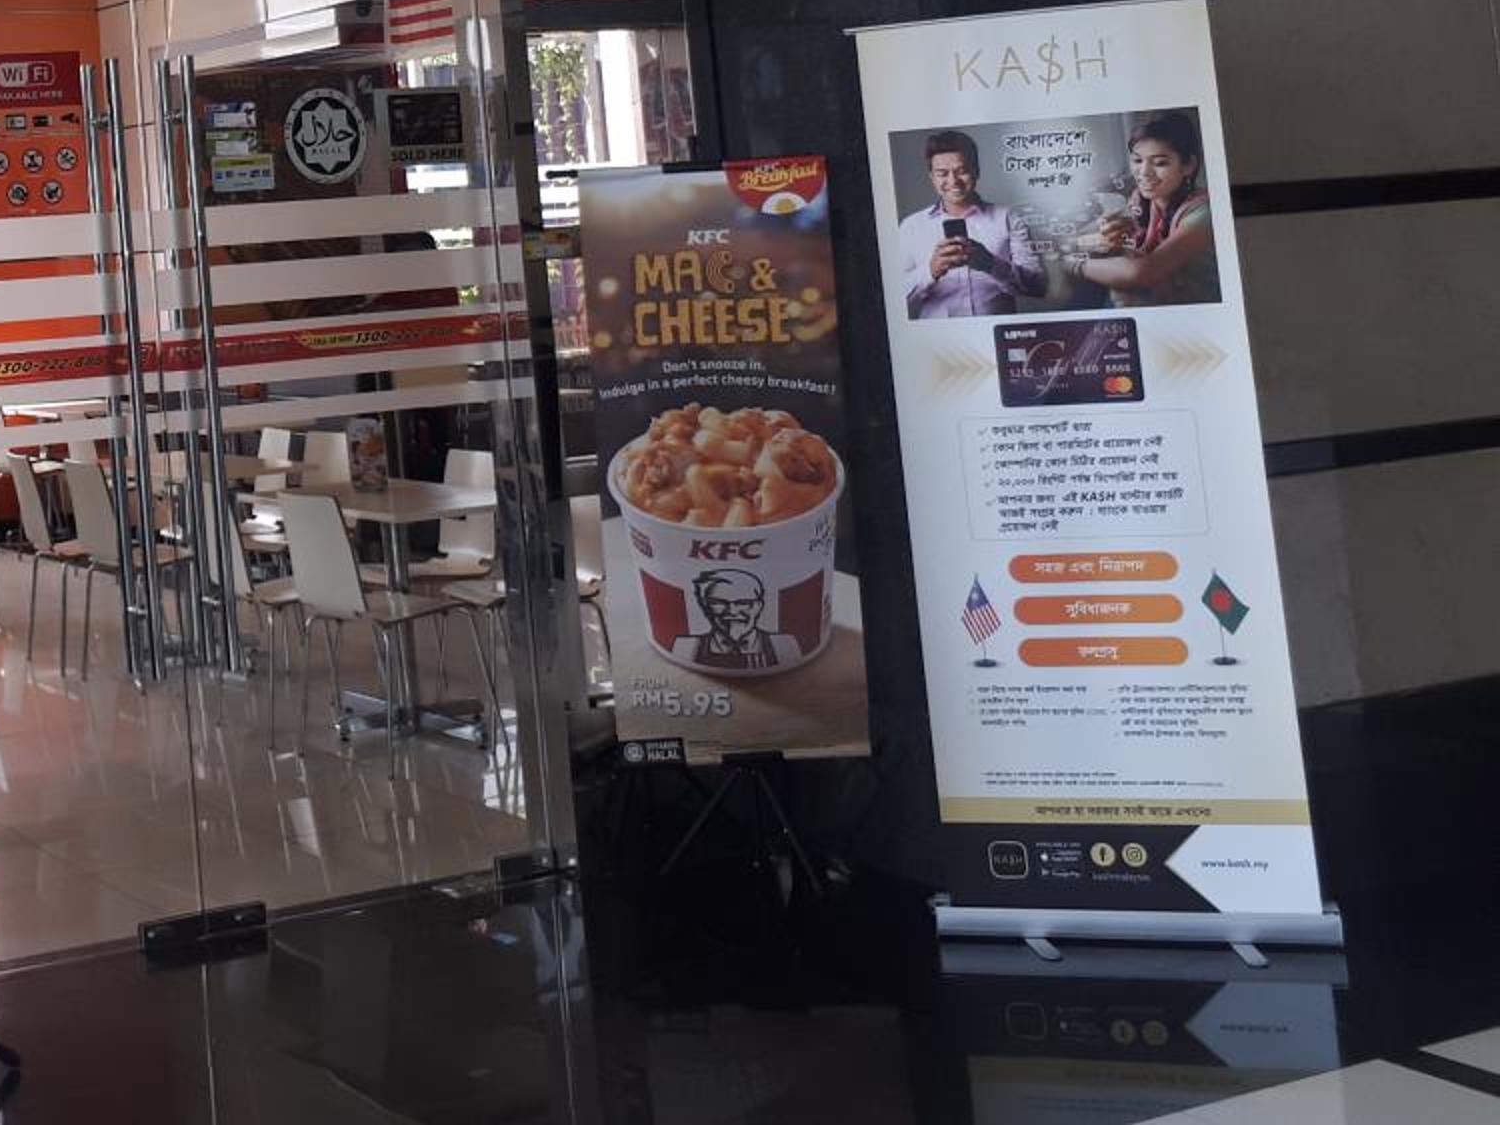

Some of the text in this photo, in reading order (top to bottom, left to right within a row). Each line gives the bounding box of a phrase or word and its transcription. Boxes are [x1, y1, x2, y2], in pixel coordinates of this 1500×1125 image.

[687, 228, 731, 246] KFC
[633, 249, 778, 295] MAC &
[633, 298, 792, 348] CHEESE
[662, 358, 697, 373] Don't
[699, 360, 746, 370] snooze
[599, 382, 645, 399] Indulge
[647, 379, 660, 389] in
[662, 379, 671, 388] a
[672, 374, 718, 390] perfect
[721, 374, 765, 389] cheesy
[1080, 491, 1116, 502] KASH
[687, 538, 766, 561] KFC
[632, 691, 733, 717] RM5.95
